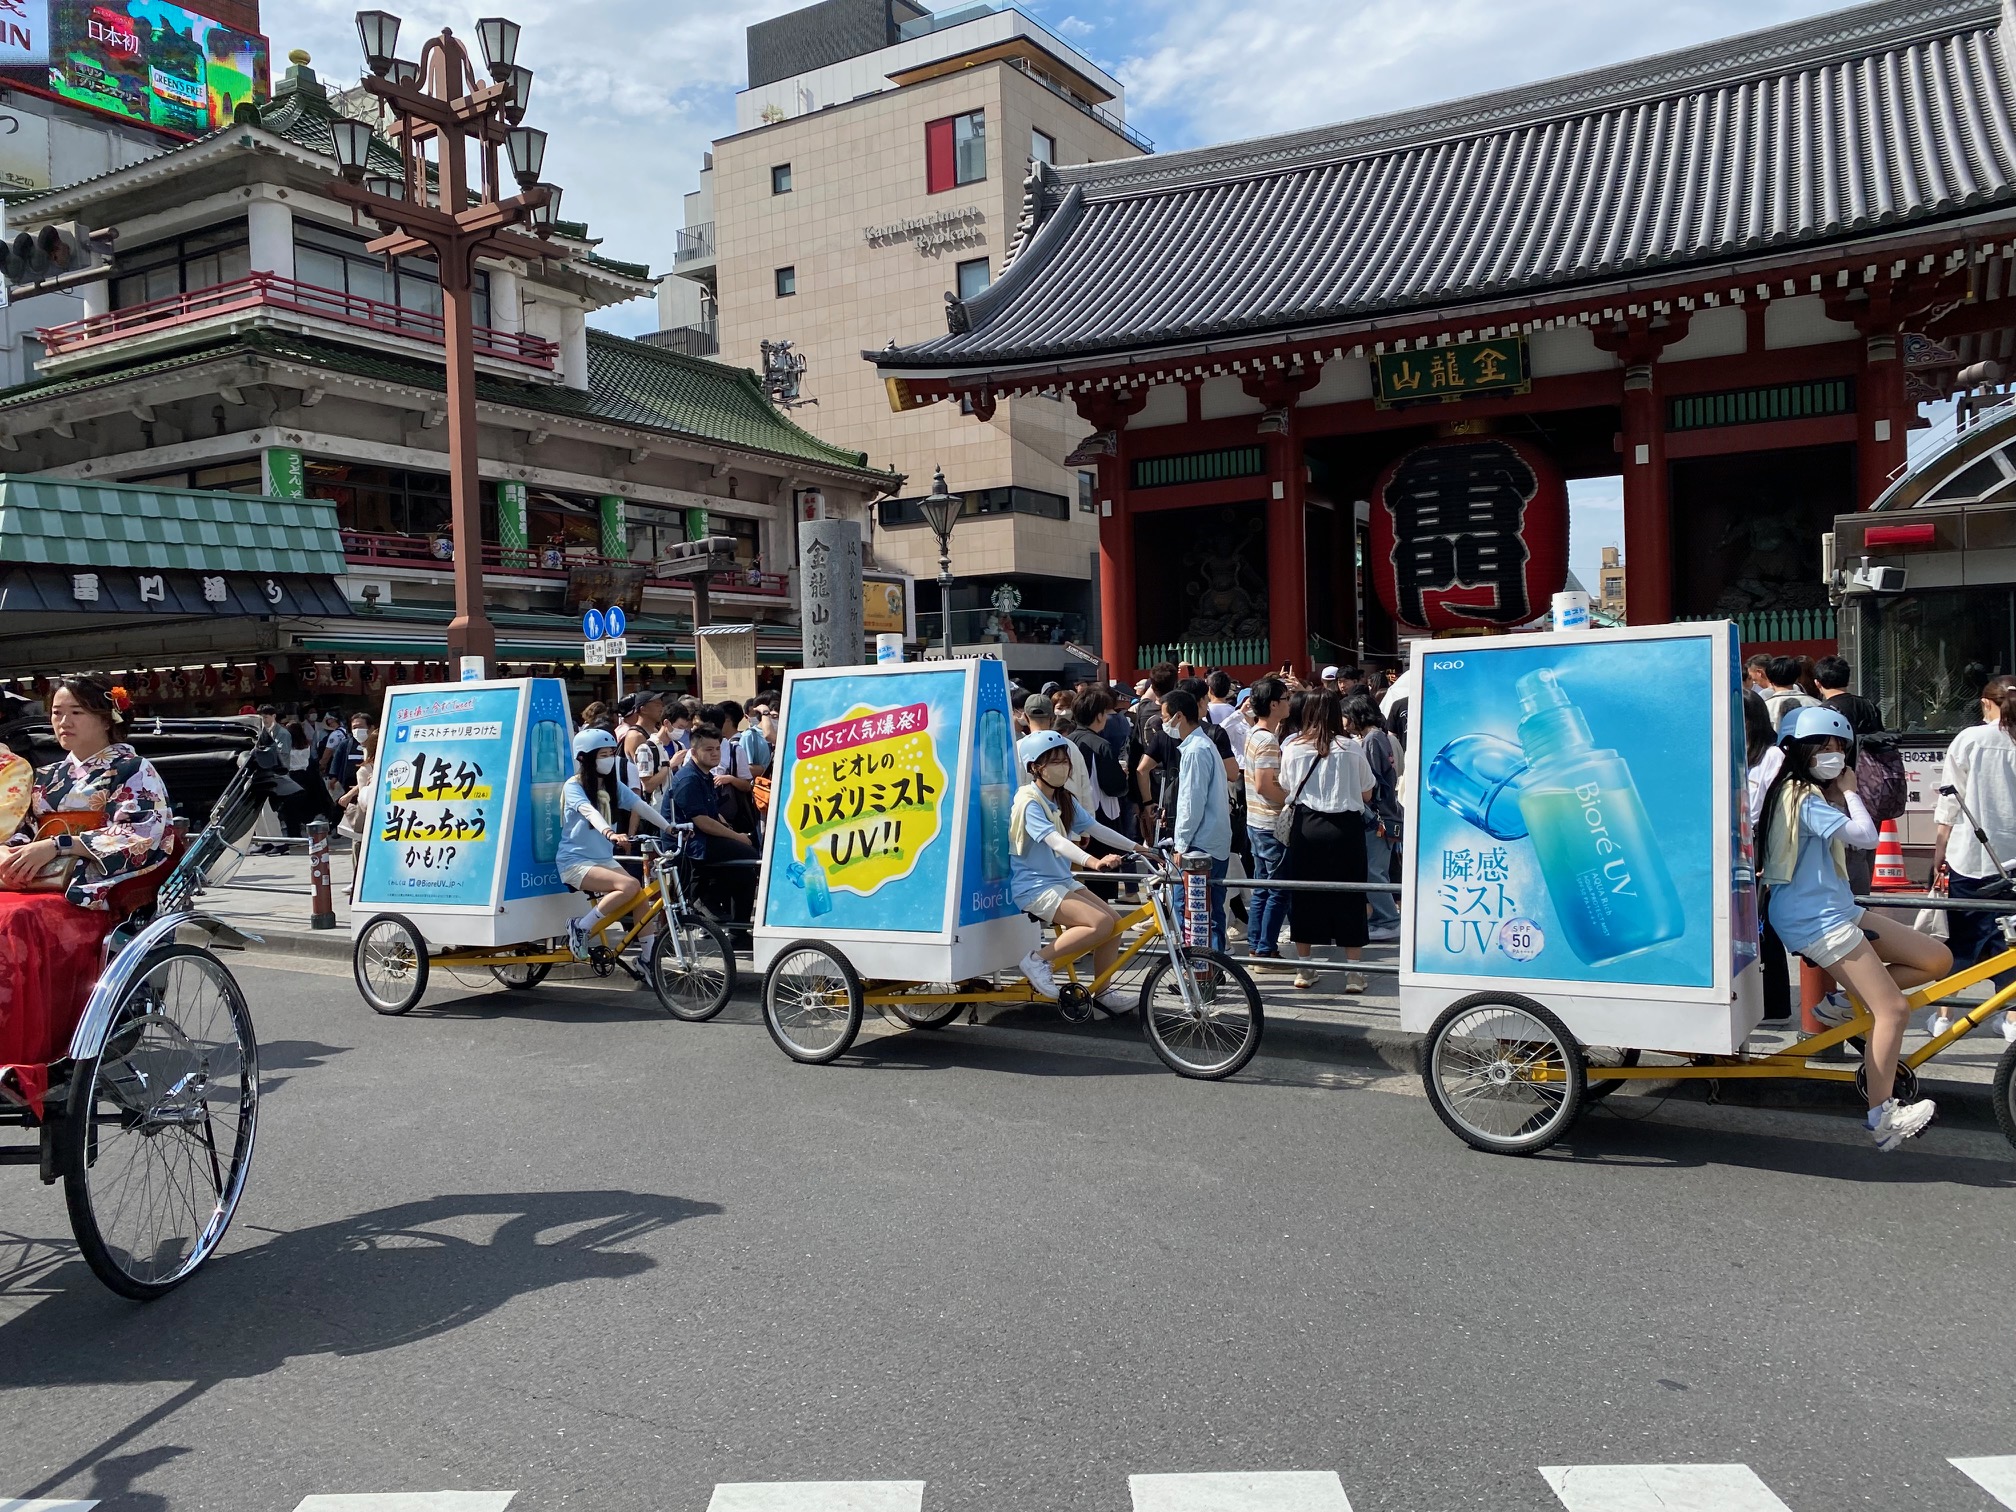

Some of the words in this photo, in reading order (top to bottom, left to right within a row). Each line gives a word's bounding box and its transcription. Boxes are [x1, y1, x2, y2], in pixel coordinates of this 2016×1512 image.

[186, 85, 203, 98] FREE
[862, 205, 979, 241] Kaminarimon
[914, 225, 978, 250] Ryokan
[73, 573, 283, 604] 雷門通り
[923, 652, 994, 662] STABUCKS
[413, 725, 498, 738] #ミストチャリ見つけた
[802, 708, 922, 754] SNSで人気爆発!
[405, 752, 484, 801] 1年分
[833, 753, 894, 782] ビオレの
[800, 772, 935, 831] バズリミスト
[384, 805, 486, 842] 当たっちゃう
[831, 821, 901, 866] UV!!
[1575, 781, 1621, 856] Bioré
[1604, 857, 1637, 898] UV
[405, 846, 457, 871] かも!?
[1442, 847, 1509, 882] 瞬感
[416, 878, 456, 889] @BioreUV_jp
[521, 868, 558, 888] Bioré
[1592, 872, 1606, 897] AQUA
[972, 888, 1003, 912] Bioré
[1440, 883, 1516, 919] ミスト
[1441, 920, 1499, 955] UV
[1512, 925, 1532, 933] SPF
[1512, 934, 1531, 948] 50
